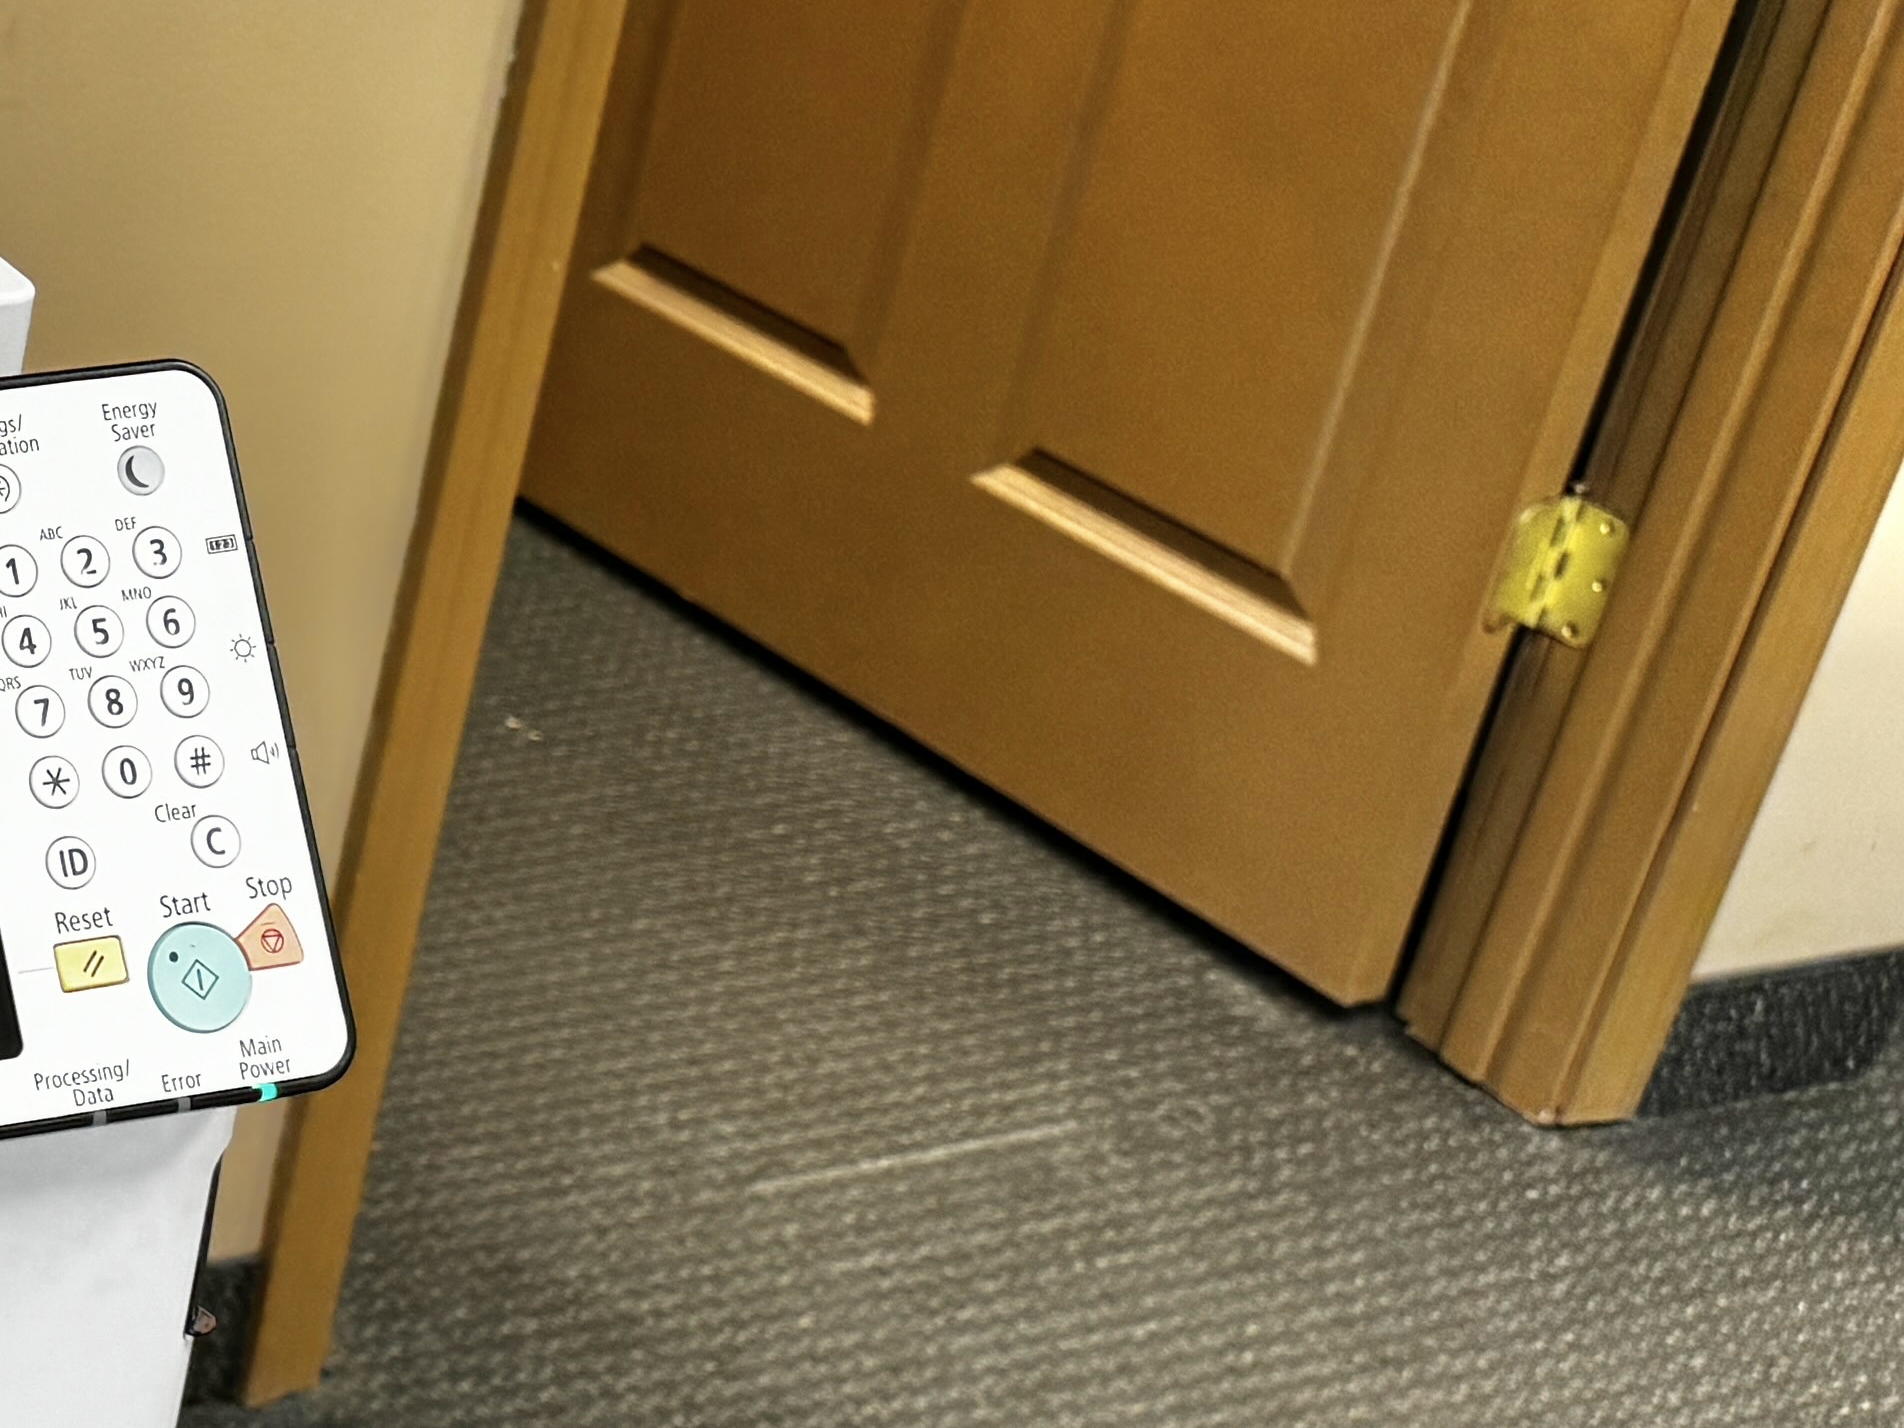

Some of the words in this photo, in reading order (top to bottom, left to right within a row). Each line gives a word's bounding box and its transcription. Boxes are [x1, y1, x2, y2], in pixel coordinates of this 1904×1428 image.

[102, 401, 158, 422] Energy
[111, 423, 156, 442] Saver
[40, 526, 64, 542] ABC
[114, 516, 137, 532] DEF
[76, 547, 97, 576] 2
[149, 538, 168, 568] 3
[5, 557, 20, 586] 1
[120, 585, 152, 602] MNO
[91, 617, 110, 646] 5
[162, 607, 181, 636] 6
[18, 626, 38, 656] 4
[68, 665, 93, 681] TUV
[129, 655, 166, 673] WXYZ
[104, 687, 124, 716] 8
[176, 677, 195, 706] 9
[33, 697, 50, 727] 7
[119, 757, 138, 786] 0
[189, 745, 212, 776] #
[154, 802, 197, 824] Clear
[205, 826, 226, 856] C
[58, 847, 89, 878] ID
[246, 876, 293, 901] Stop
[160, 891, 212, 919] Start
[55, 906, 114, 935] Reset
[240, 1036, 282, 1058] Main
[34, 1058, 130, 1091] Processing/
[160, 1073, 202, 1093] Error
[238, 1058, 291, 1081] Power
[73, 1087, 115, 1107] Data
